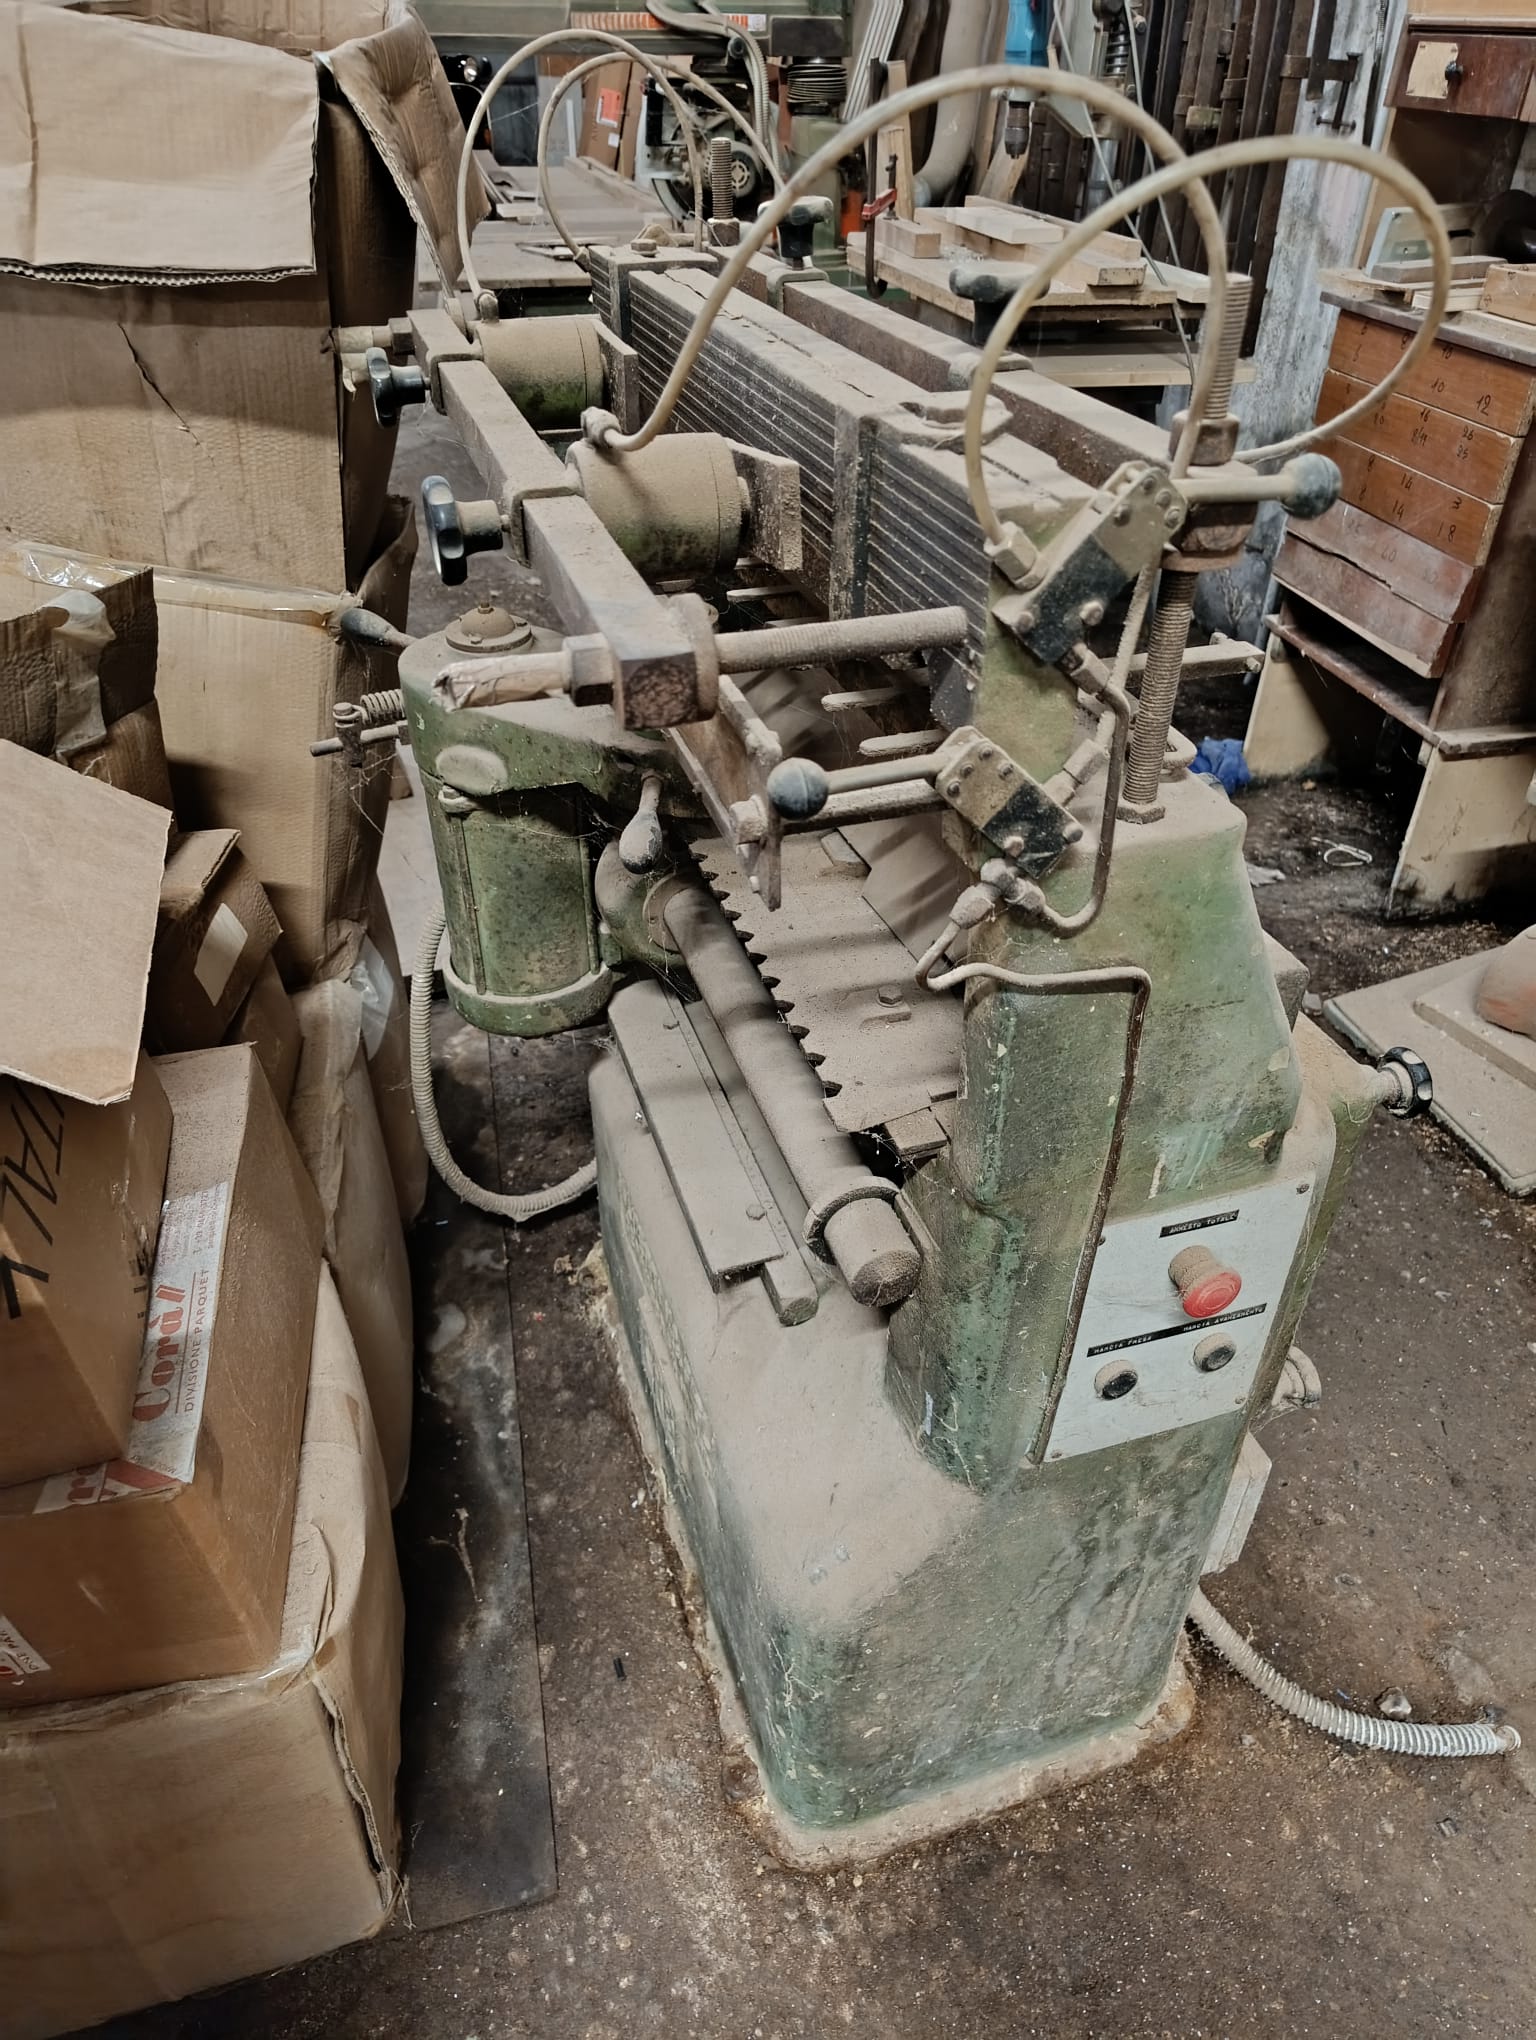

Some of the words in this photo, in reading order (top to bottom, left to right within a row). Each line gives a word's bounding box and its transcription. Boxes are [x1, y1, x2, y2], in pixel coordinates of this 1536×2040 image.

[1430, 377, 1445, 393] 10
[1475, 394, 1492, 417] 12
[1462, 425, 1475, 441] 26
[1392, 500, 1405, 521] 14
[184, 1341, 201, 1411] DIVISIONE
[194, 1270, 209, 1334] PARQUET
[131, 1307, 181, 1421] Corà
